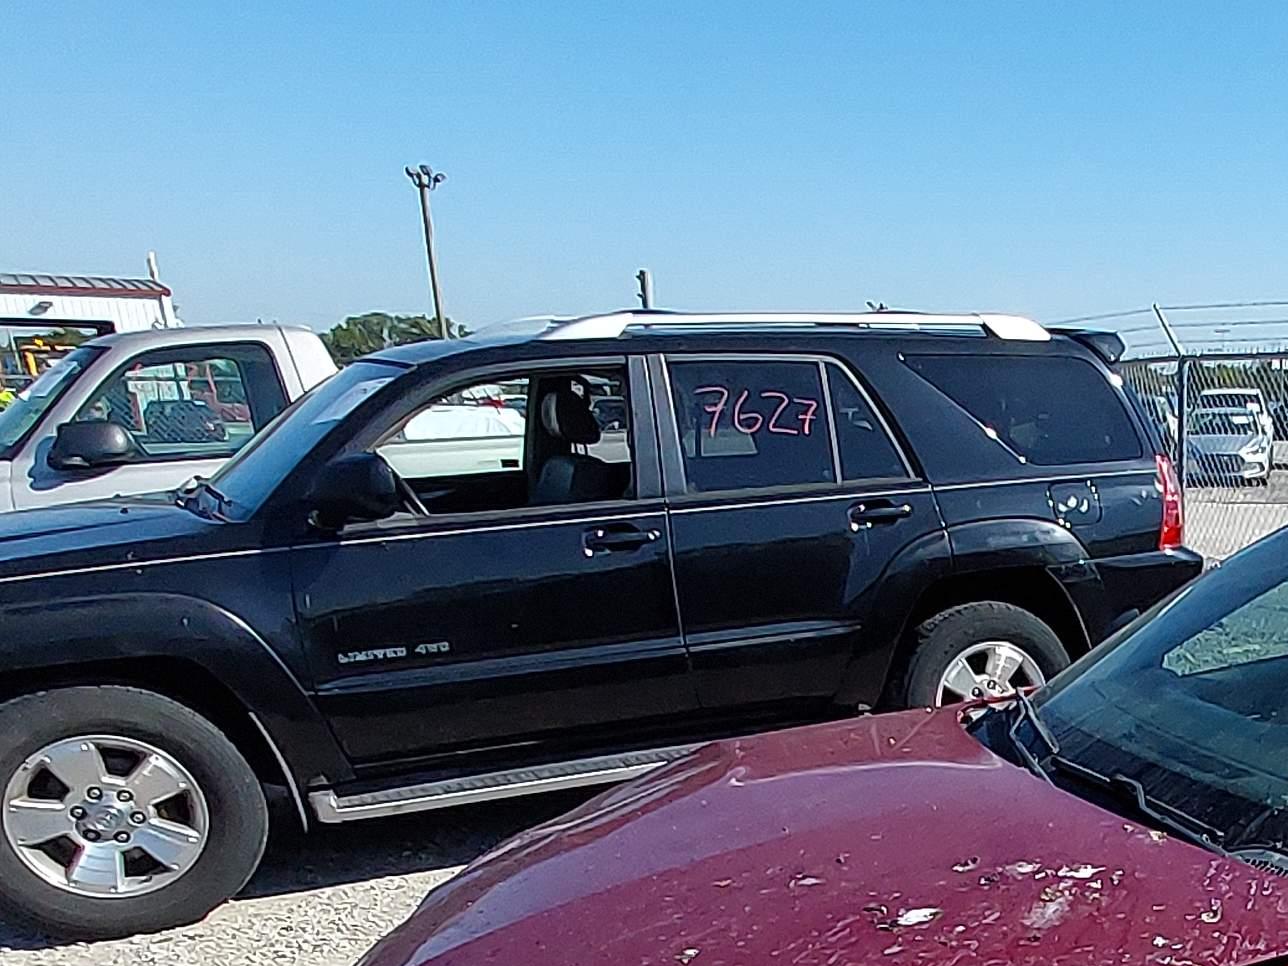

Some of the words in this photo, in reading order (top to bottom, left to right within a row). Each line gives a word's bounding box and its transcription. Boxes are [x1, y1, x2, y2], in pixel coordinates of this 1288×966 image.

[693, 385, 817, 438] 7627
[337, 646, 407, 664] LIMITED
[414, 641, 450, 655] 4WD
